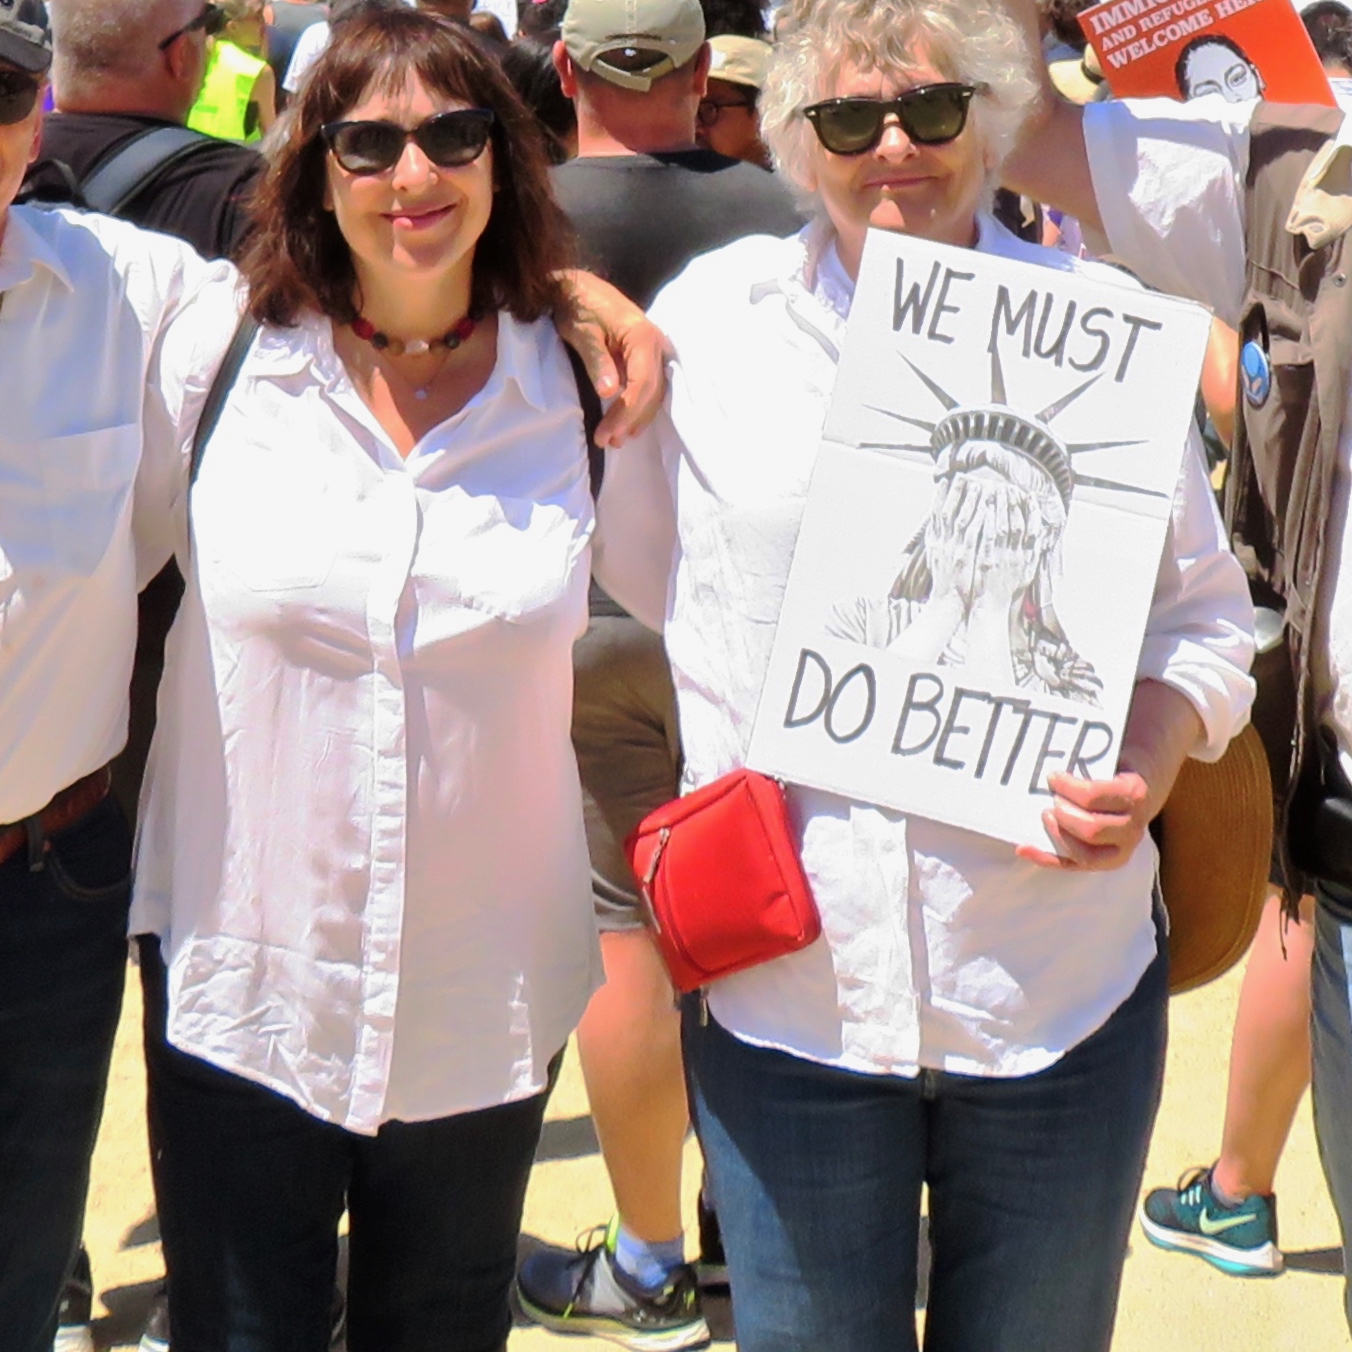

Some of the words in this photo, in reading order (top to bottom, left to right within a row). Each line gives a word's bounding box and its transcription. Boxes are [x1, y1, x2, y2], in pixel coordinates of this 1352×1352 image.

[1101, 22, 1137, 52] AND
[1106, 8, 1214, 70] WELCOME
[891, 256, 976, 345] WE
[986, 284, 1164, 383] MUST
[782, 647, 877, 745] DO
[890, 672, 1115, 796] BETTER
